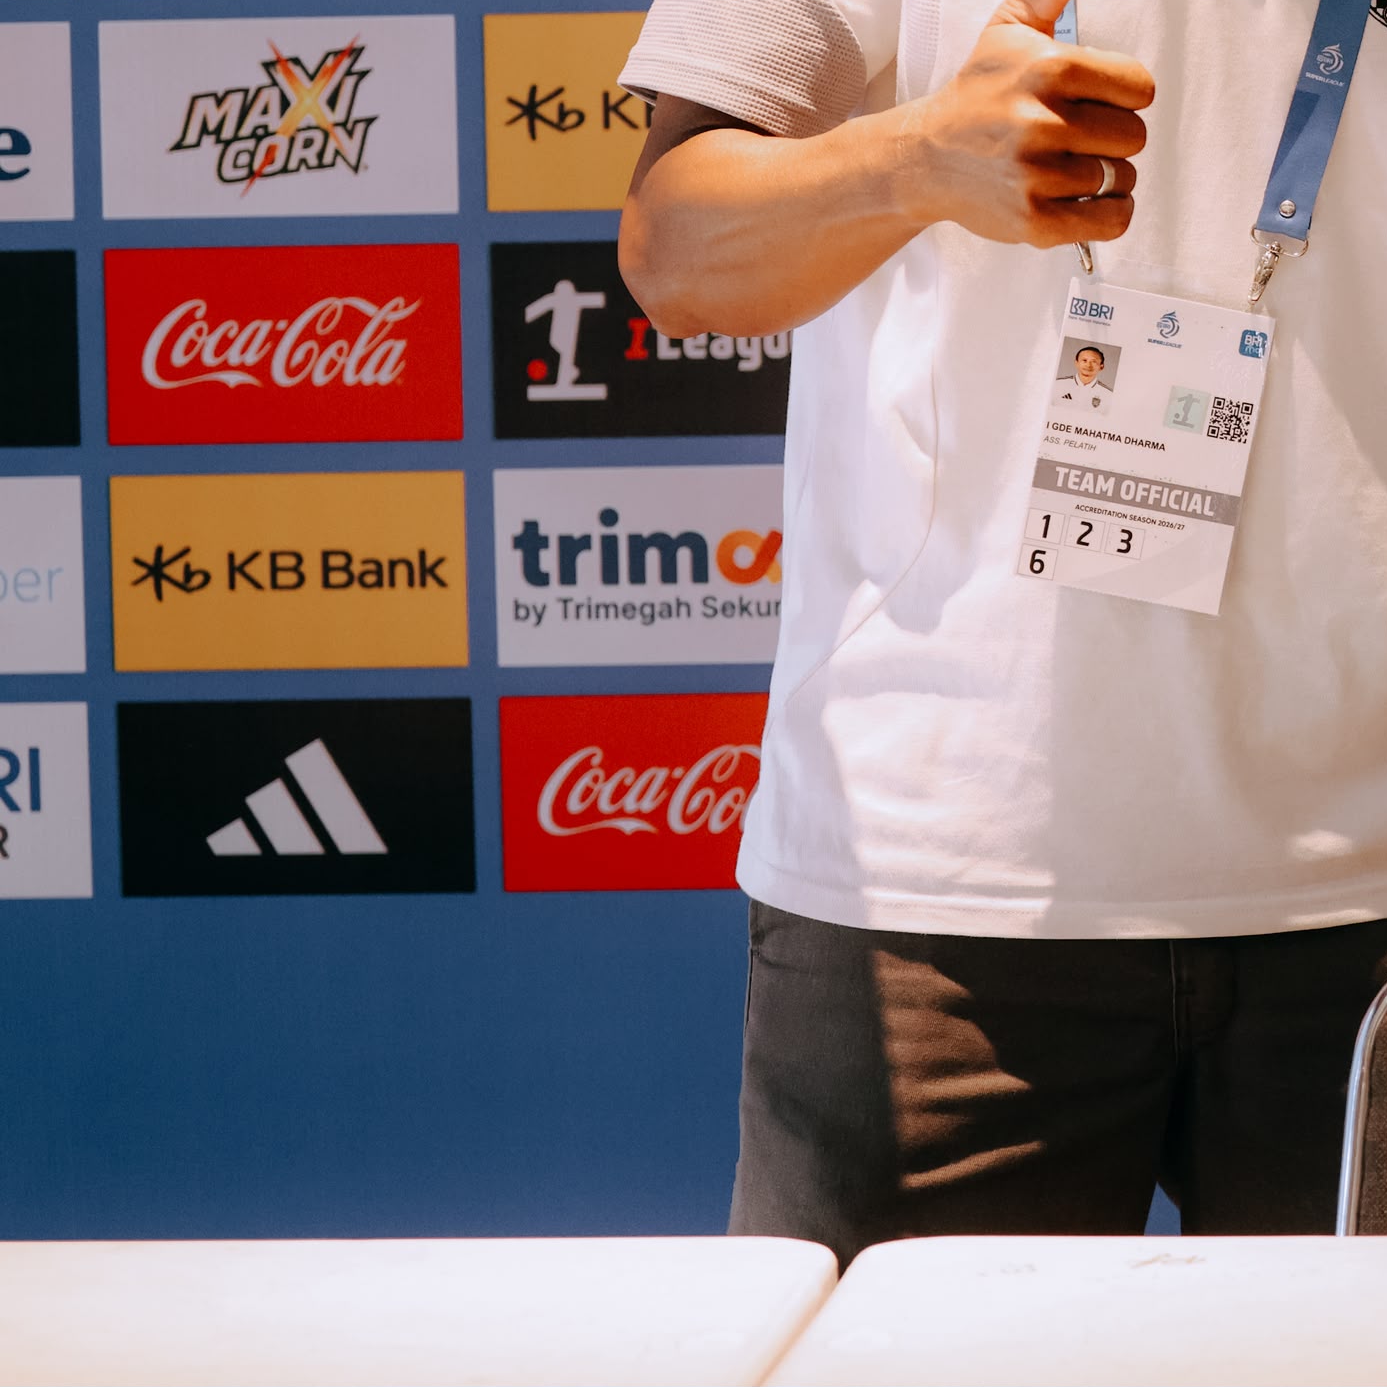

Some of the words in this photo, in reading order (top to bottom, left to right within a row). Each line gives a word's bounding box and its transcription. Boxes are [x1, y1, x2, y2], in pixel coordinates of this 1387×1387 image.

[169, 39, 375, 153] MAXI
[216, 115, 380, 187] CORN
[1088, 302, 1115, 321] BRI
[142, 295, 422, 389] Coca-Cola
[1045, 420, 1050, 430] I
[1050, 422, 1072, 435] GDE
[1073, 425, 1122, 443] MAHATMA
[1124, 435, 1166, 452] DHARMA
[1063, 439, 1097, 452] PELATIH
[1054, 466, 1116, 497] TEAM
[1120, 478, 1216, 517] OFFICIAL
[1074, 503, 1128, 522] ACCREDITATION
[1128, 513, 1157, 526] SEASON
[1041, 514, 1052, 539] 1
[1076, 521, 1094, 547] 2
[1116, 528, 1134, 555] 3
[227, 550, 306, 592] KB
[321, 547, 449, 591] Bank
[1028, 549, 1047, 575] 6
[512, 598, 547, 628] by
[556, 595, 692, 625] Trimegah
[701, 593, 782, 620] Sekur
